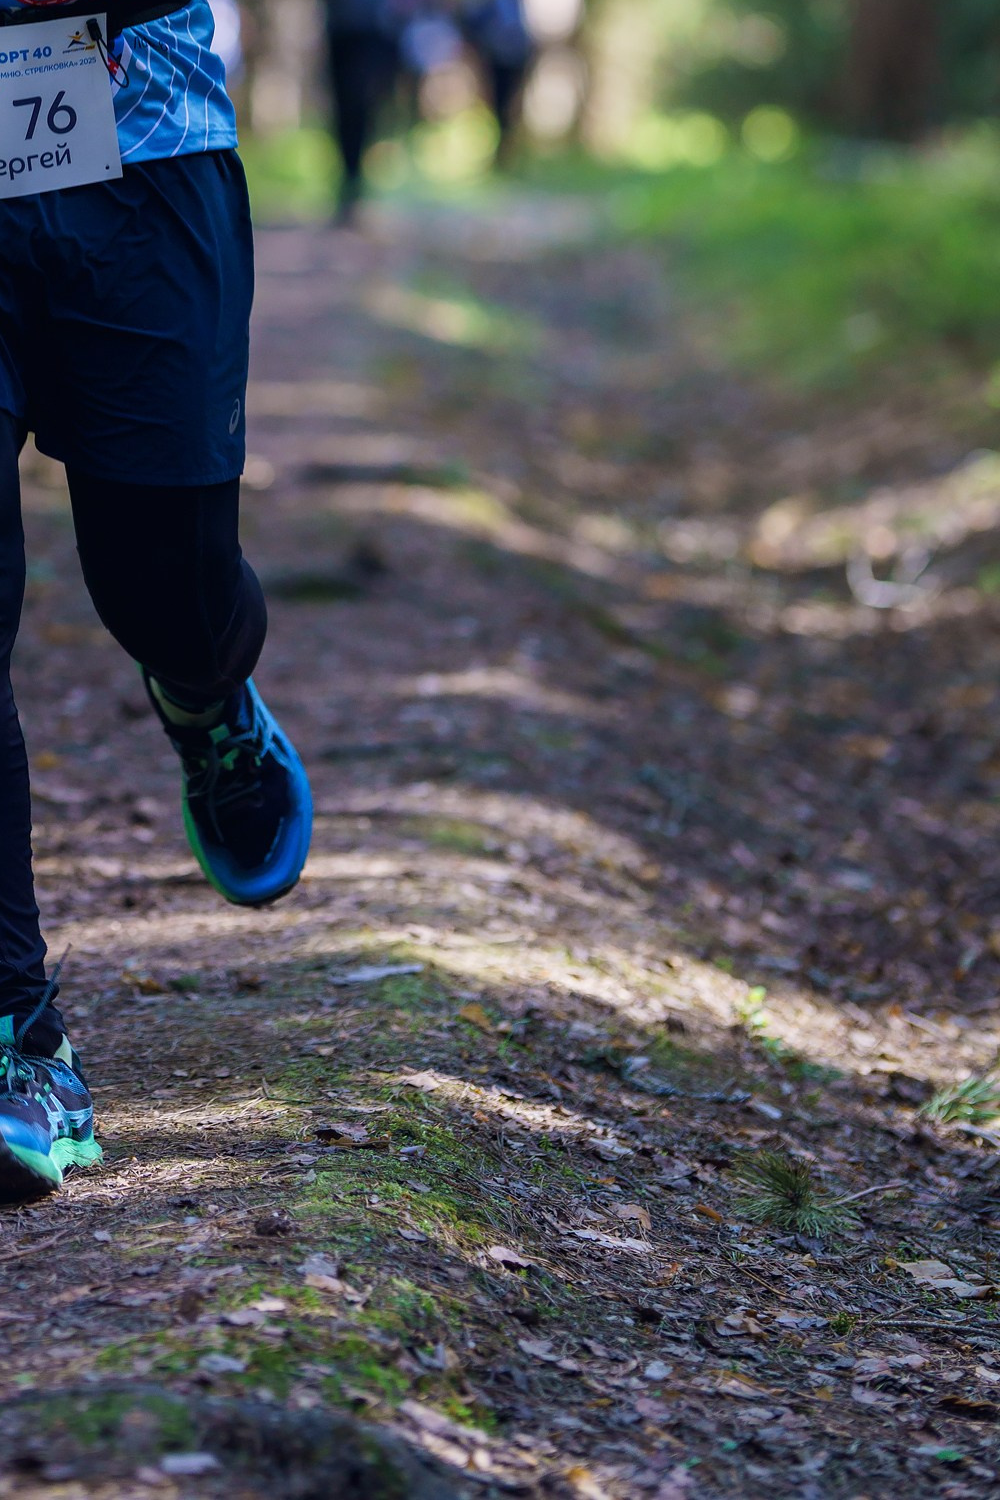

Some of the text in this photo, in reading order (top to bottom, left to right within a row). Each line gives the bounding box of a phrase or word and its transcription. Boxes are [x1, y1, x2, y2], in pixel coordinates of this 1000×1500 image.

[33, 46, 52, 60] 40
[79, 56, 97, 67] 2025
[12, 90, 77, 141] 76
